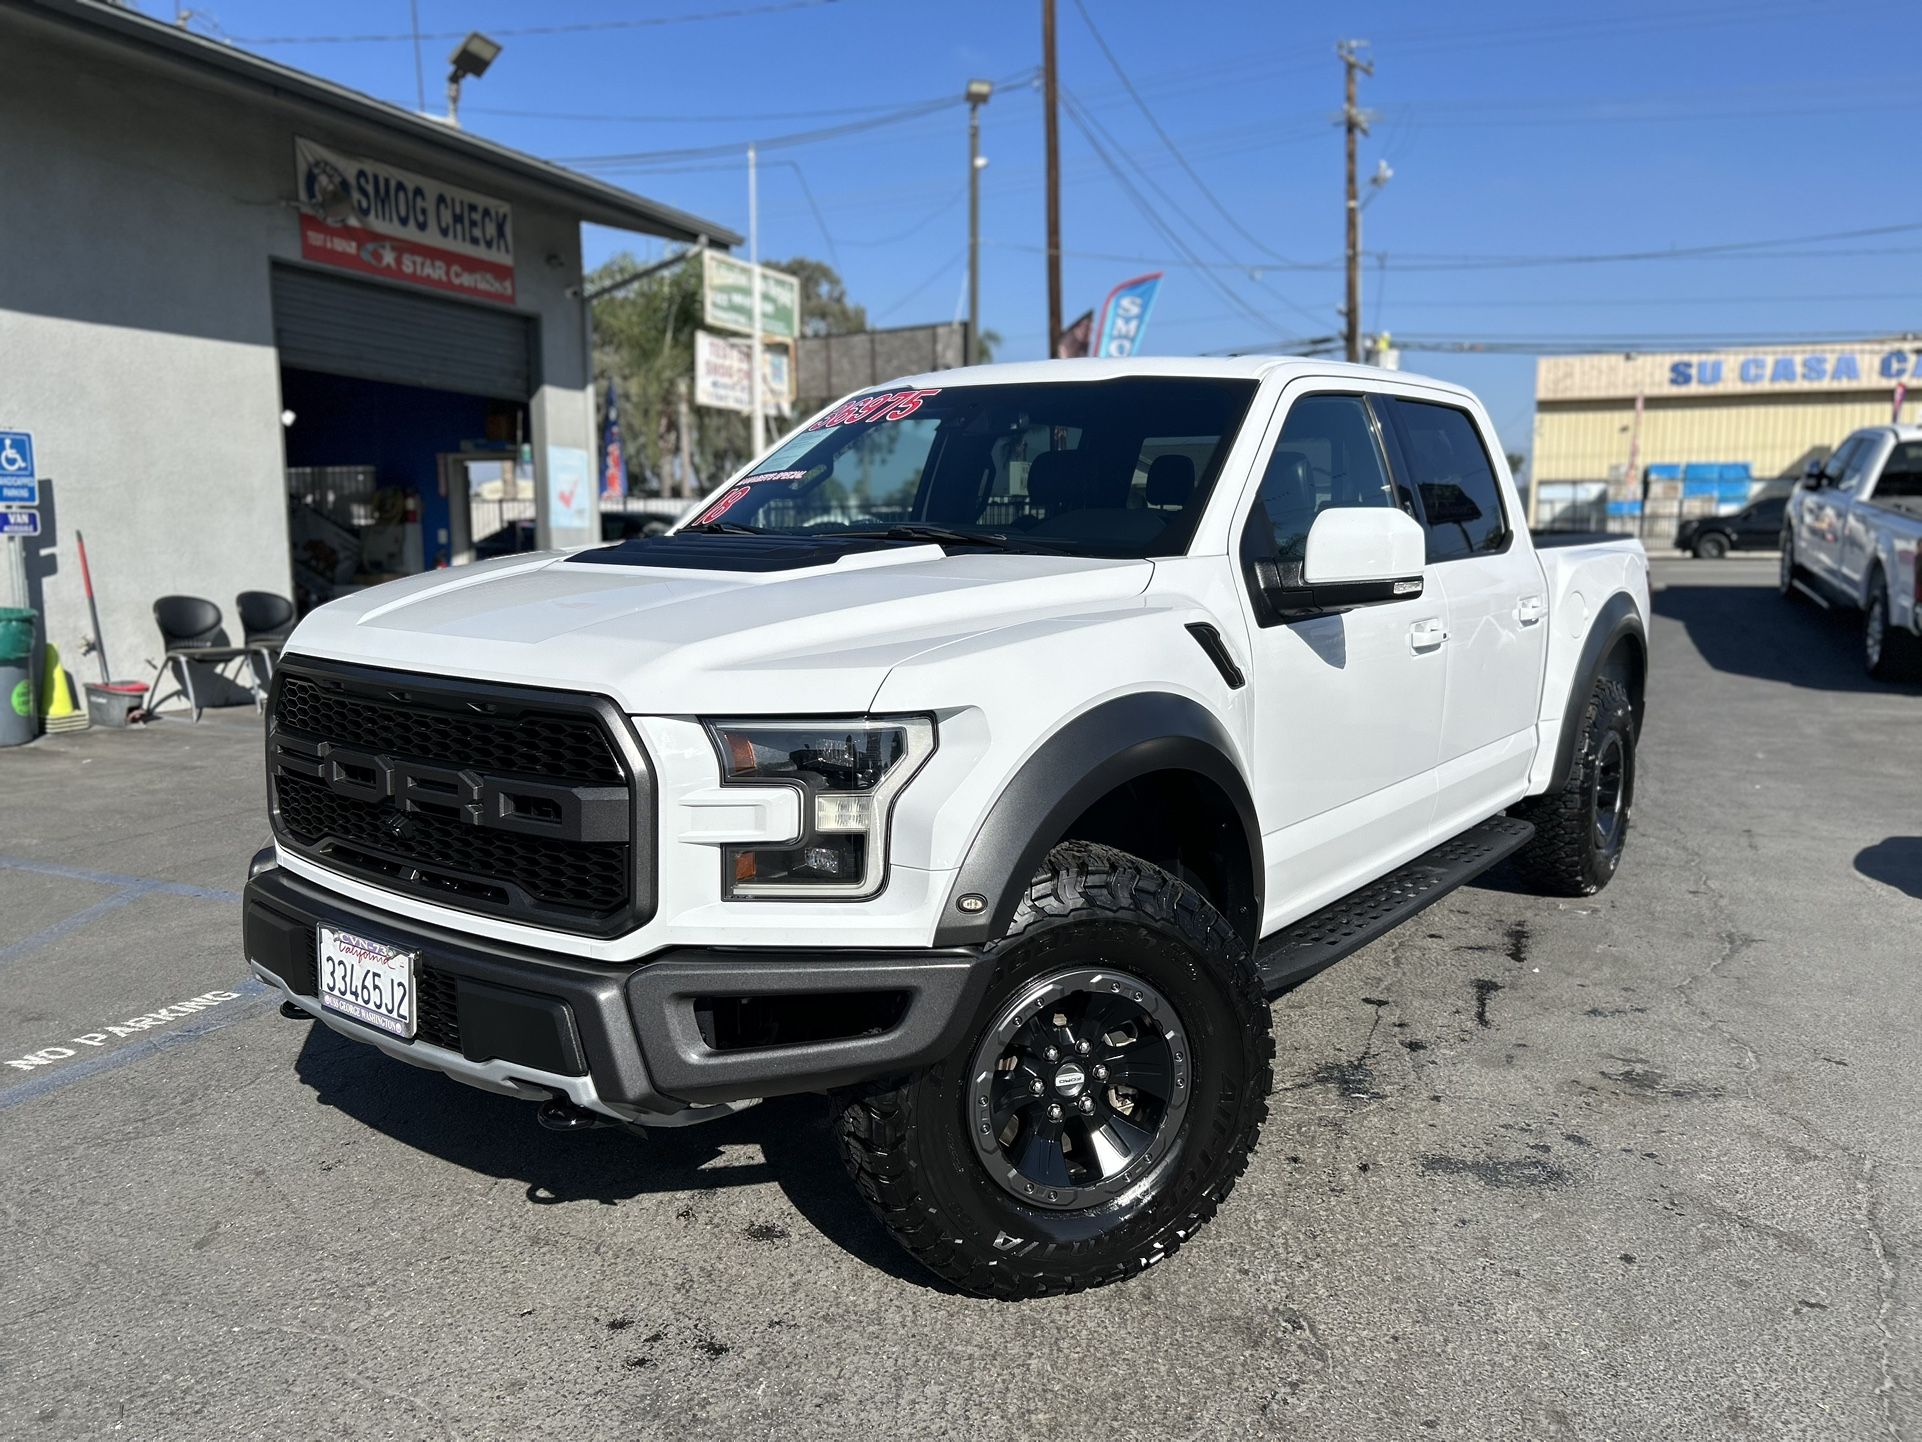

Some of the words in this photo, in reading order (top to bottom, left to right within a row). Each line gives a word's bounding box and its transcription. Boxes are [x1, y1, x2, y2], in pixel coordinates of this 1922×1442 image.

[355, 169, 429, 233] SMOG
[436, 193, 511, 255] CHECK
[401, 254, 448, 282] STAR
[1669, 360, 1724, 386] SU
[1739, 355, 1860, 384] CASA
[8, 513, 30, 524] VAN
[272, 733, 629, 843] FORD
[339, 932, 389, 955] CVN-73
[326, 955, 408, 1021] 33465J2
[4, 1047, 76, 1071] NO
[71, 990, 242, 1047] PARKING
[339, 1001, 360, 1017] GEORGE
[361, 1008, 397, 1031] WASHINGTON
